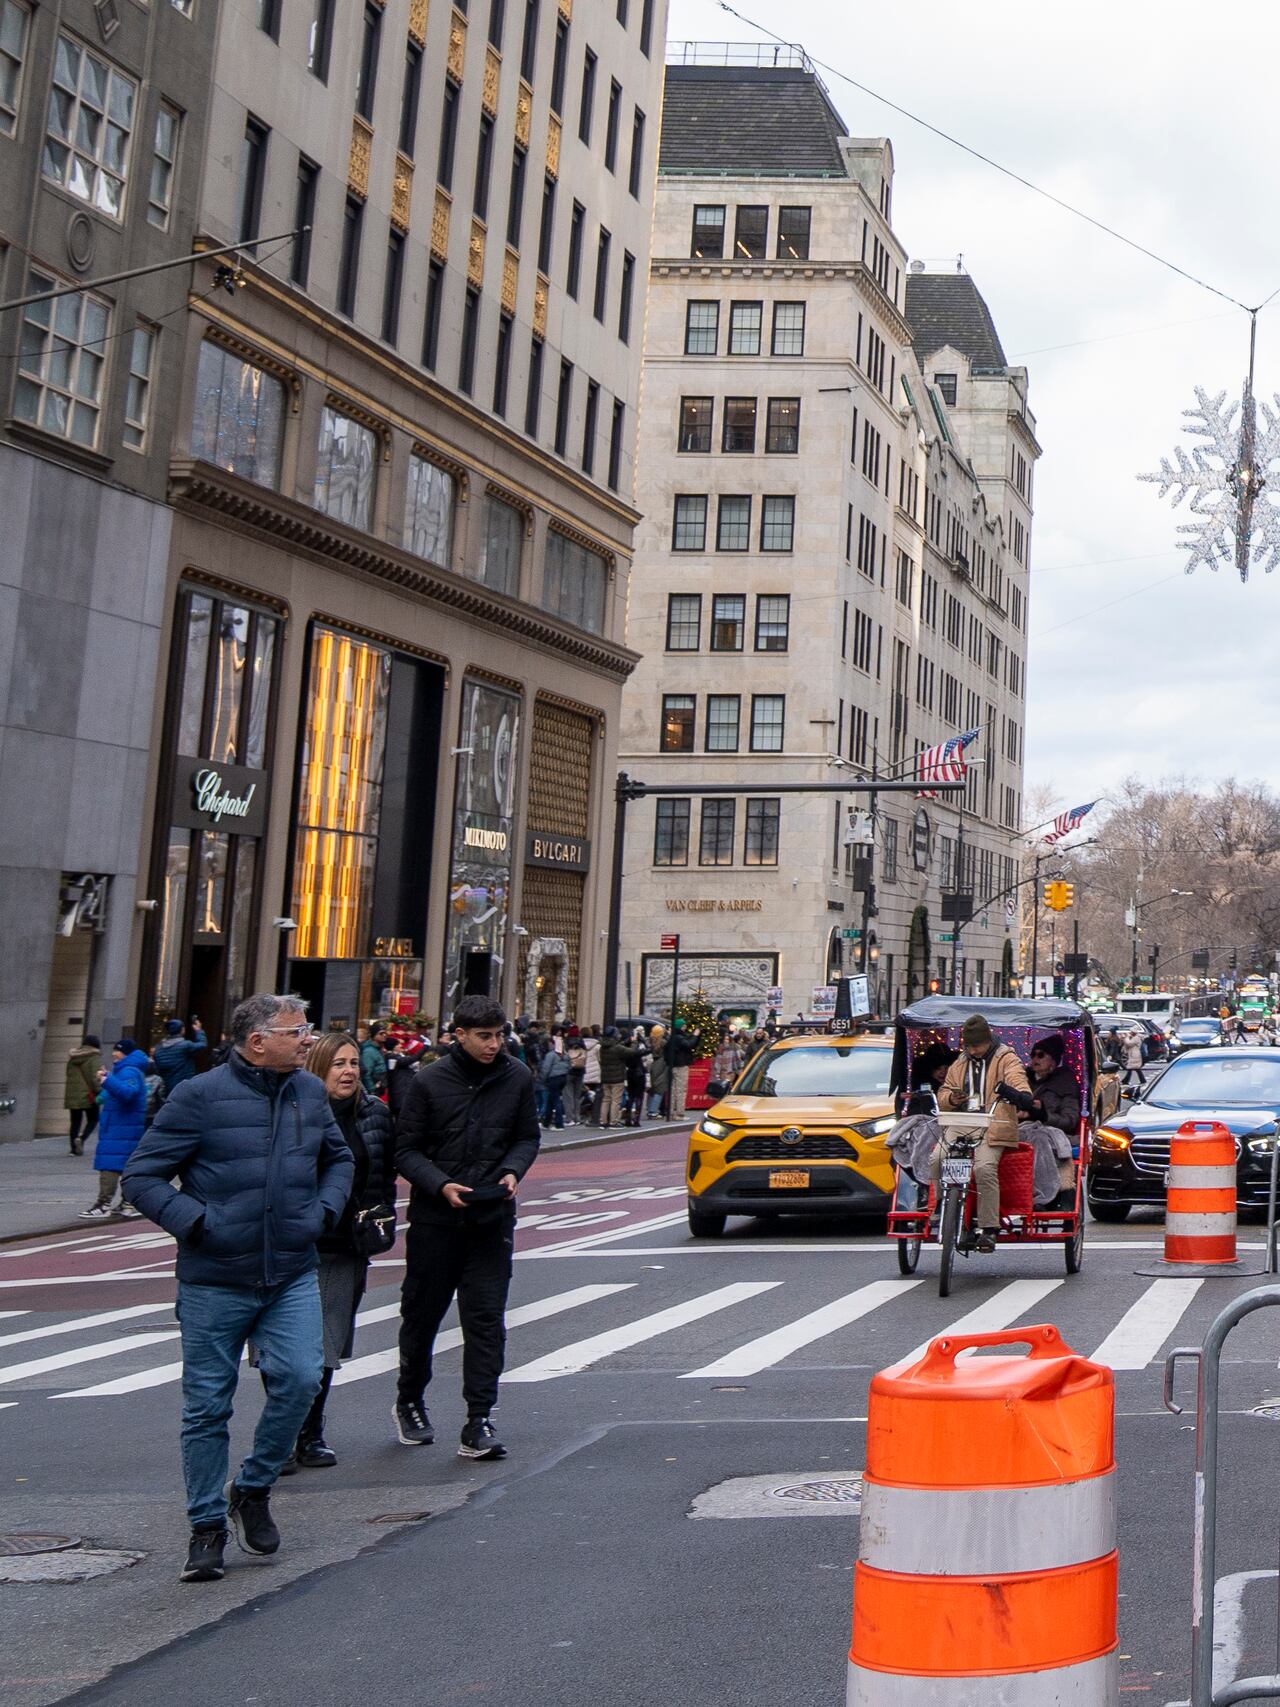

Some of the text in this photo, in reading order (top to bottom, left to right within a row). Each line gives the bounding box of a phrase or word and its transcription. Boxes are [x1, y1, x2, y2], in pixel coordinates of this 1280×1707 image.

[195, 769, 257, 822] Chopard
[464, 827, 507, 851] MIKIMOTO
[533, 839, 582, 863] BVLGARI
[665, 900, 763, 912] VAN CLEEF & ARPELS
[831, 1019, 851, 1030] 6E51
